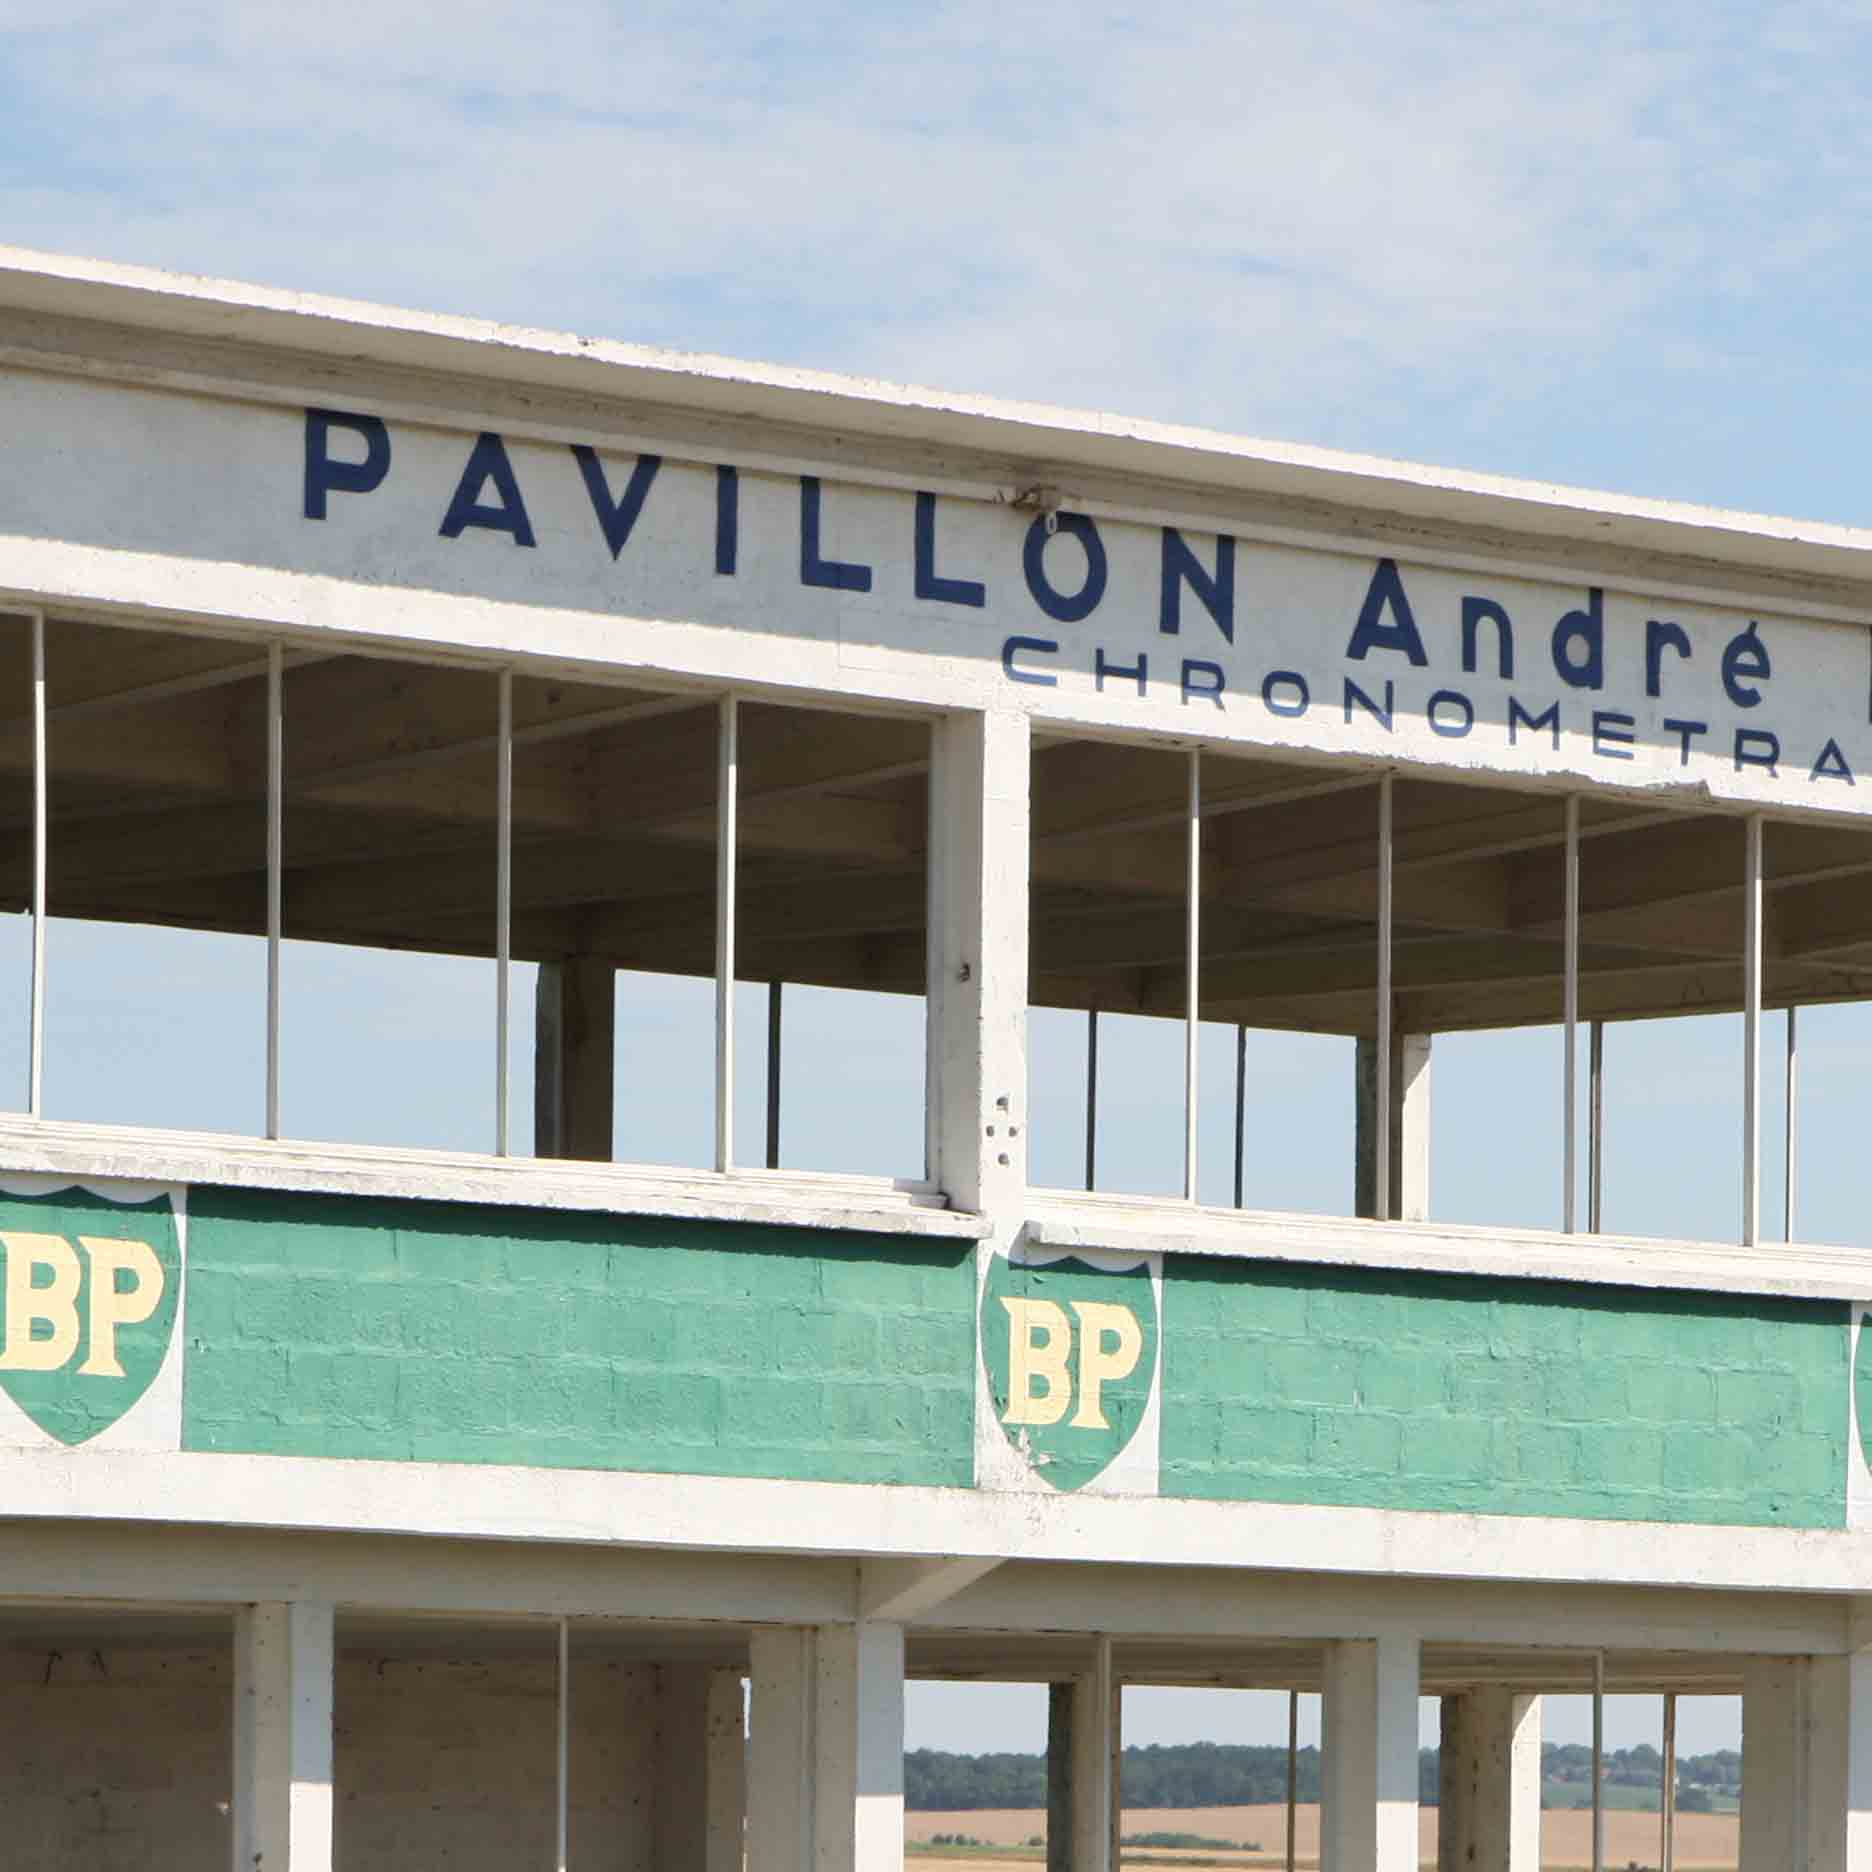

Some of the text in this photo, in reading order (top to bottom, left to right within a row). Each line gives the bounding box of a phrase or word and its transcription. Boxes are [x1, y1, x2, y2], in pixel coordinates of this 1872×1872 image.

[303, 407, 1235, 645] PAVILLON
[1346, 558, 1772, 709] André
[999, 1296, 1143, 1430] BP
